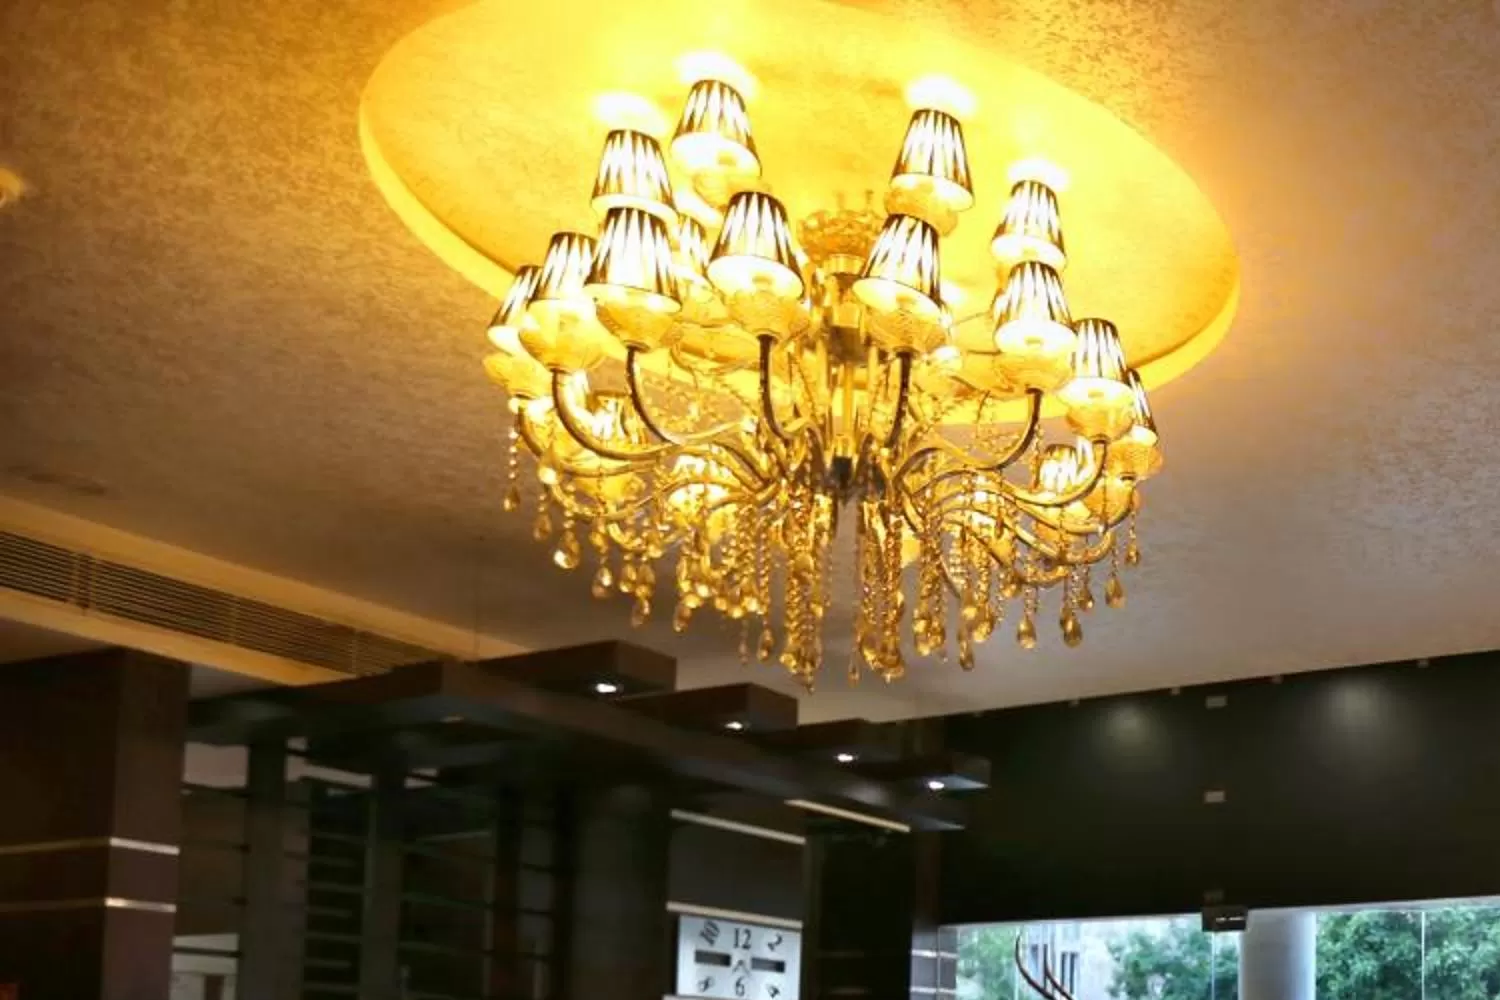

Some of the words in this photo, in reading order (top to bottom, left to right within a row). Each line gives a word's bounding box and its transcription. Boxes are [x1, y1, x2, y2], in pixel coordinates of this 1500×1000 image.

[733, 927, 752, 950] 12
[767, 932, 783, 951] 2
[735, 975, 746, 997] 6
